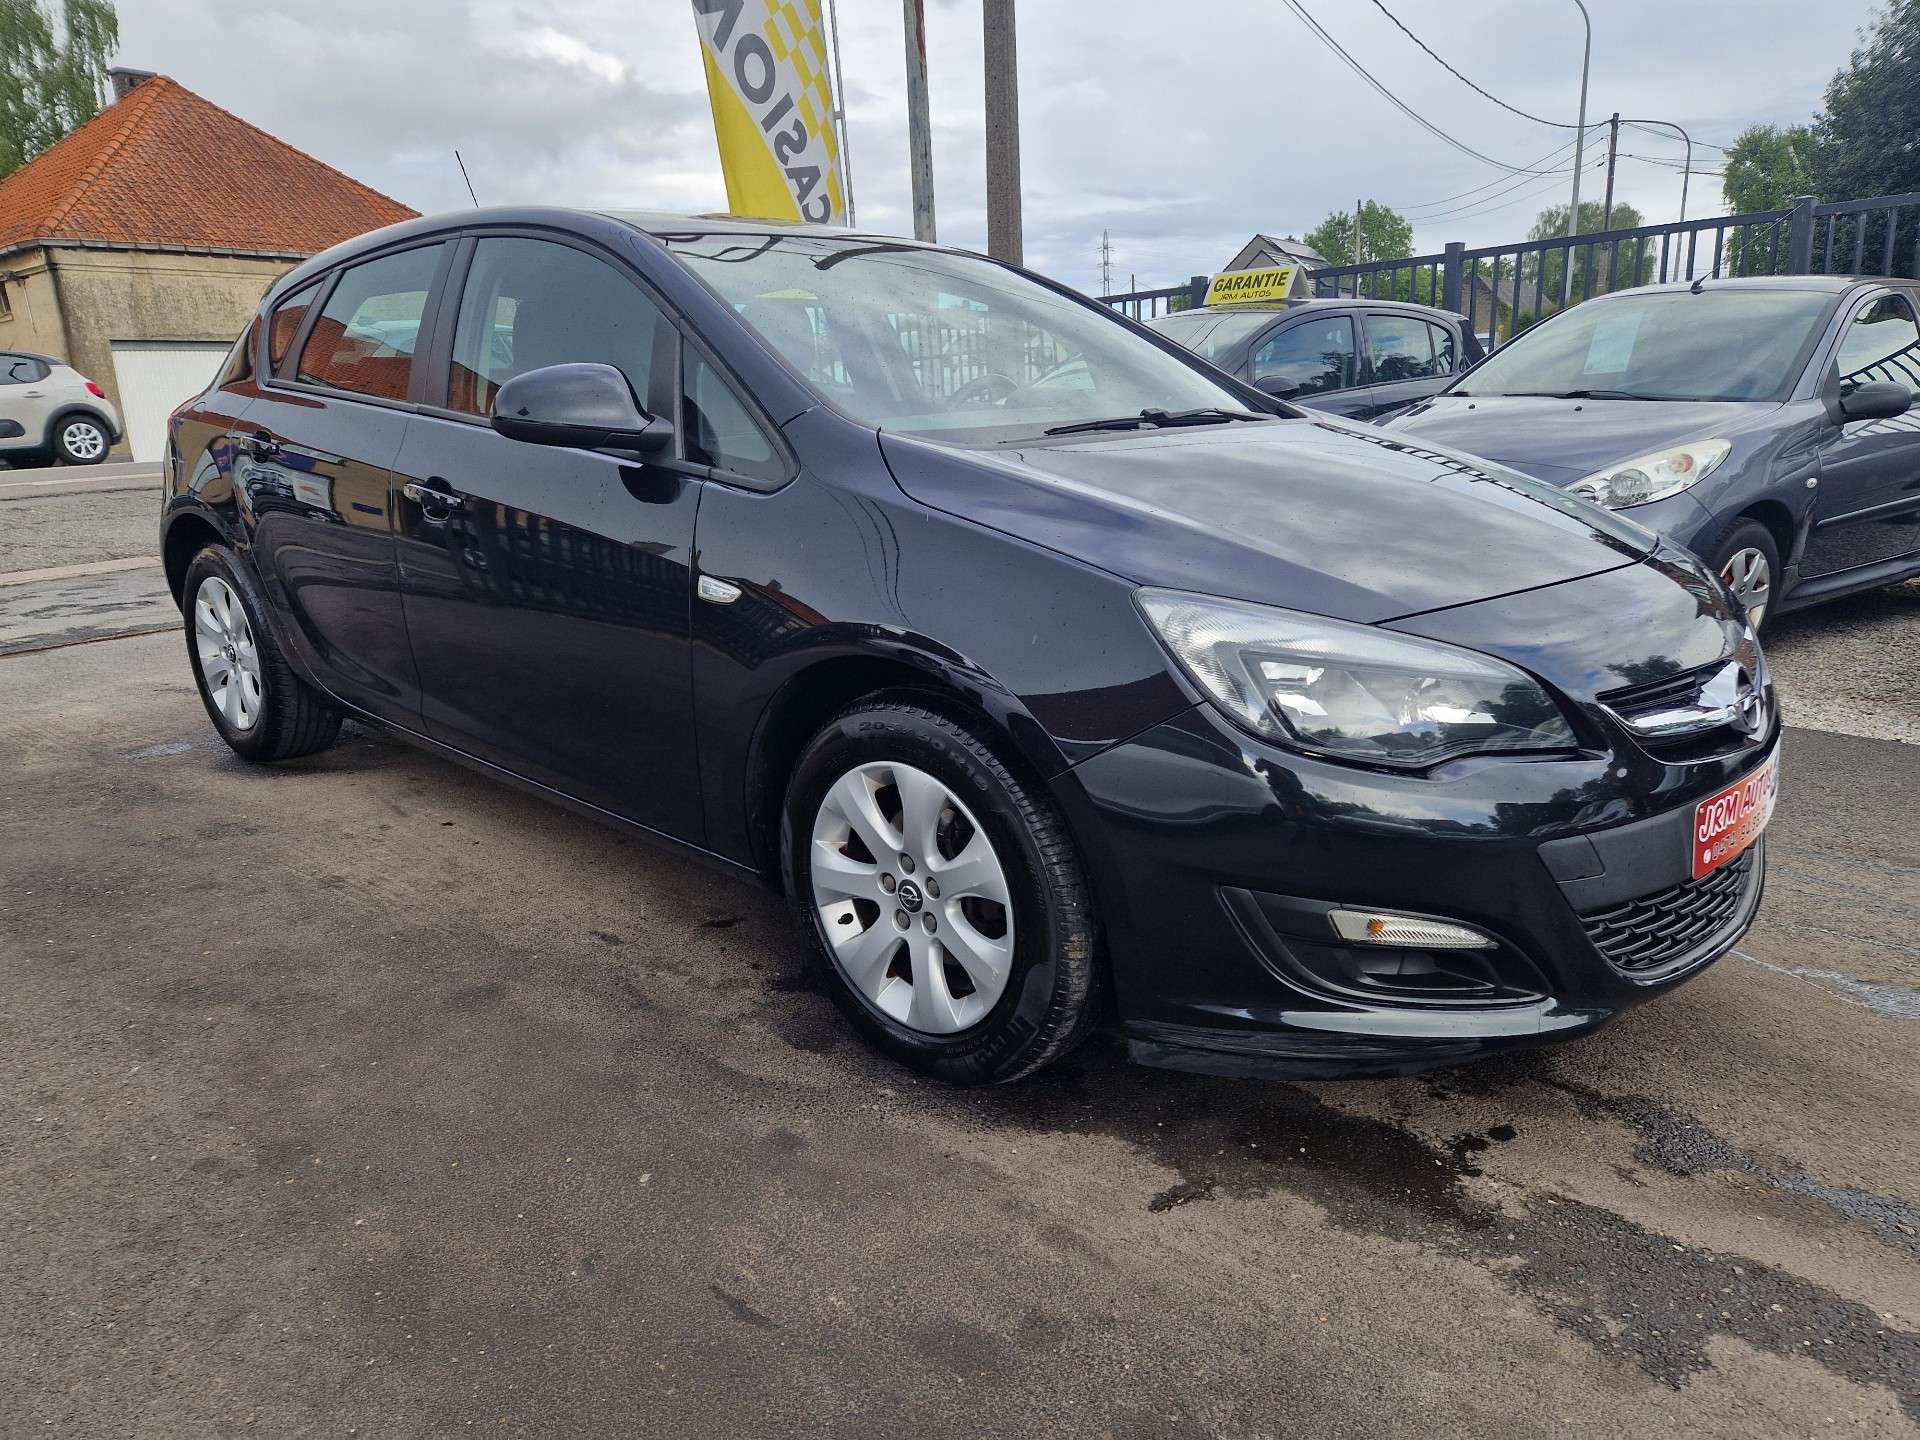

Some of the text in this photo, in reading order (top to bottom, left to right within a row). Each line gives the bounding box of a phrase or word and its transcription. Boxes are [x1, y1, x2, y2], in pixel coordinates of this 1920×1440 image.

[1213, 271, 1290, 293] GARANTIE
[1220, 289, 1272, 302] JRM AUTOS
[1699, 790, 1740, 842] JRM
